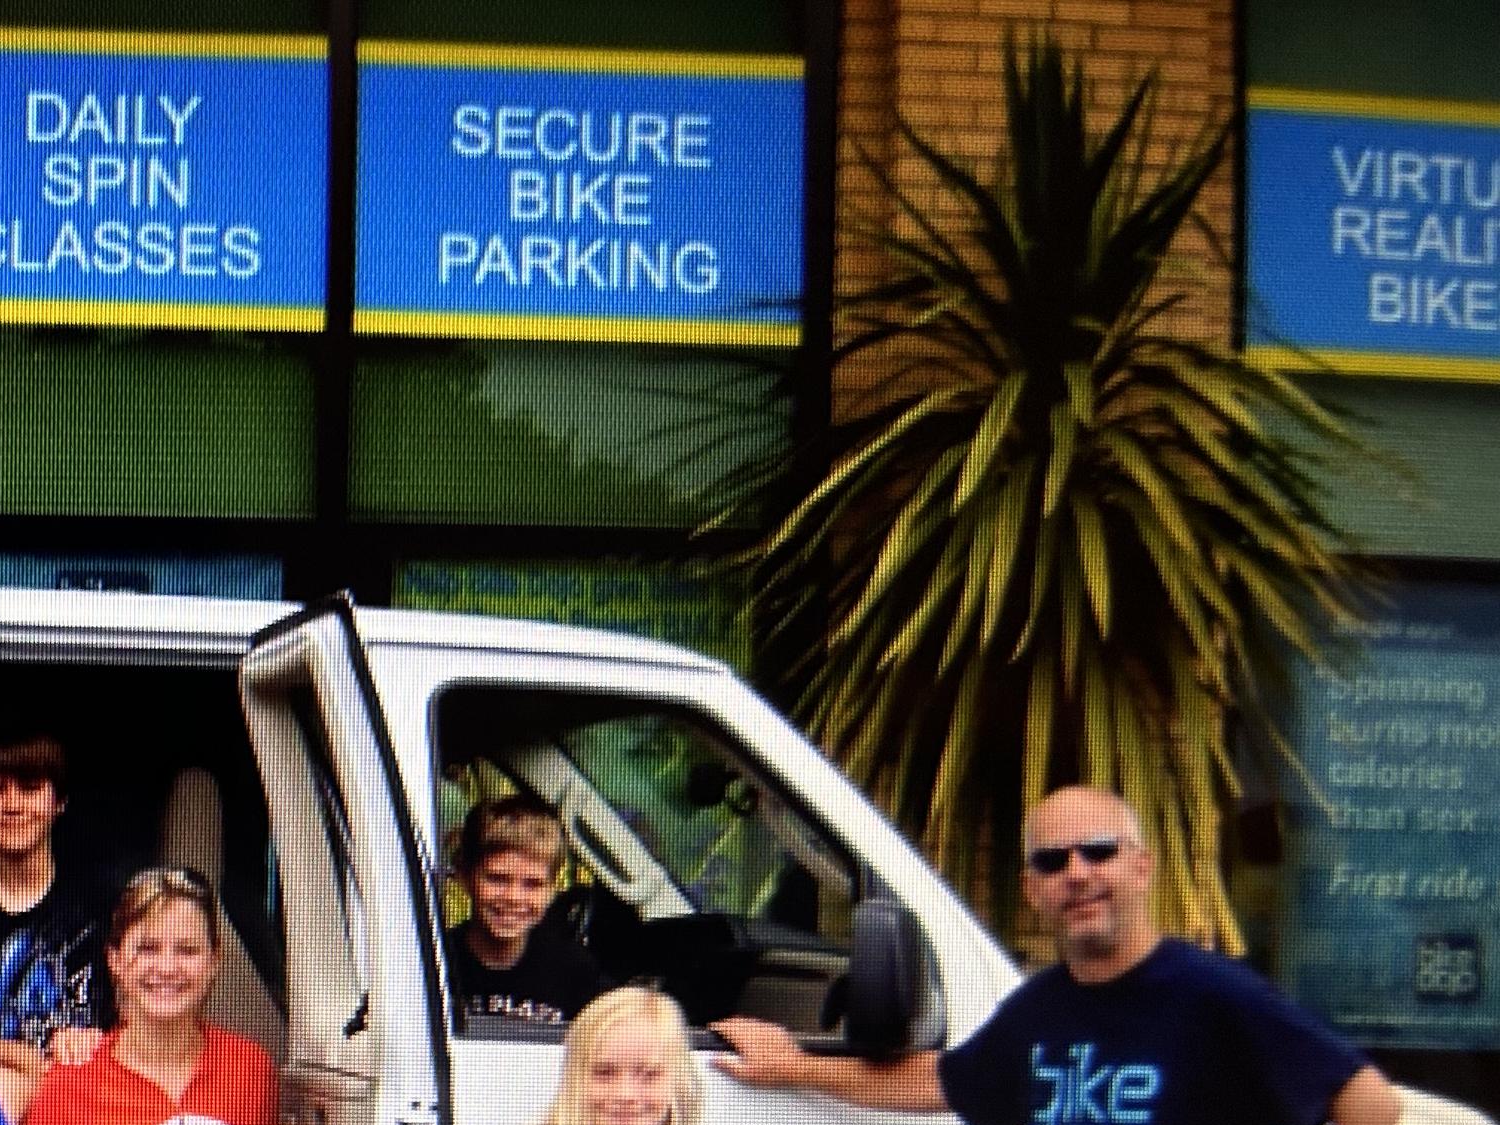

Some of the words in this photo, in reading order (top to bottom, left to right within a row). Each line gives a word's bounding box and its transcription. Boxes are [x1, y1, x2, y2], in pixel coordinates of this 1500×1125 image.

[26, 91, 202, 148] DAILY
[452, 104, 712, 169] SECURE
[42, 155, 190, 210] SPIN
[509, 170, 652, 227] BIKE
[438, 233, 719, 296] PARKING
[1331, 207, 1500, 268] REALI
[1368, 274, 1499, 331] BIKE
[1327, 674, 1486, 711] Spinning
[1328, 711, 1428, 746] burns
[1328, 757, 1465, 789] calories
[1329, 803, 1406, 830] than
[1328, 862, 1407, 897] First
[1416, 865, 1486, 899] ride
